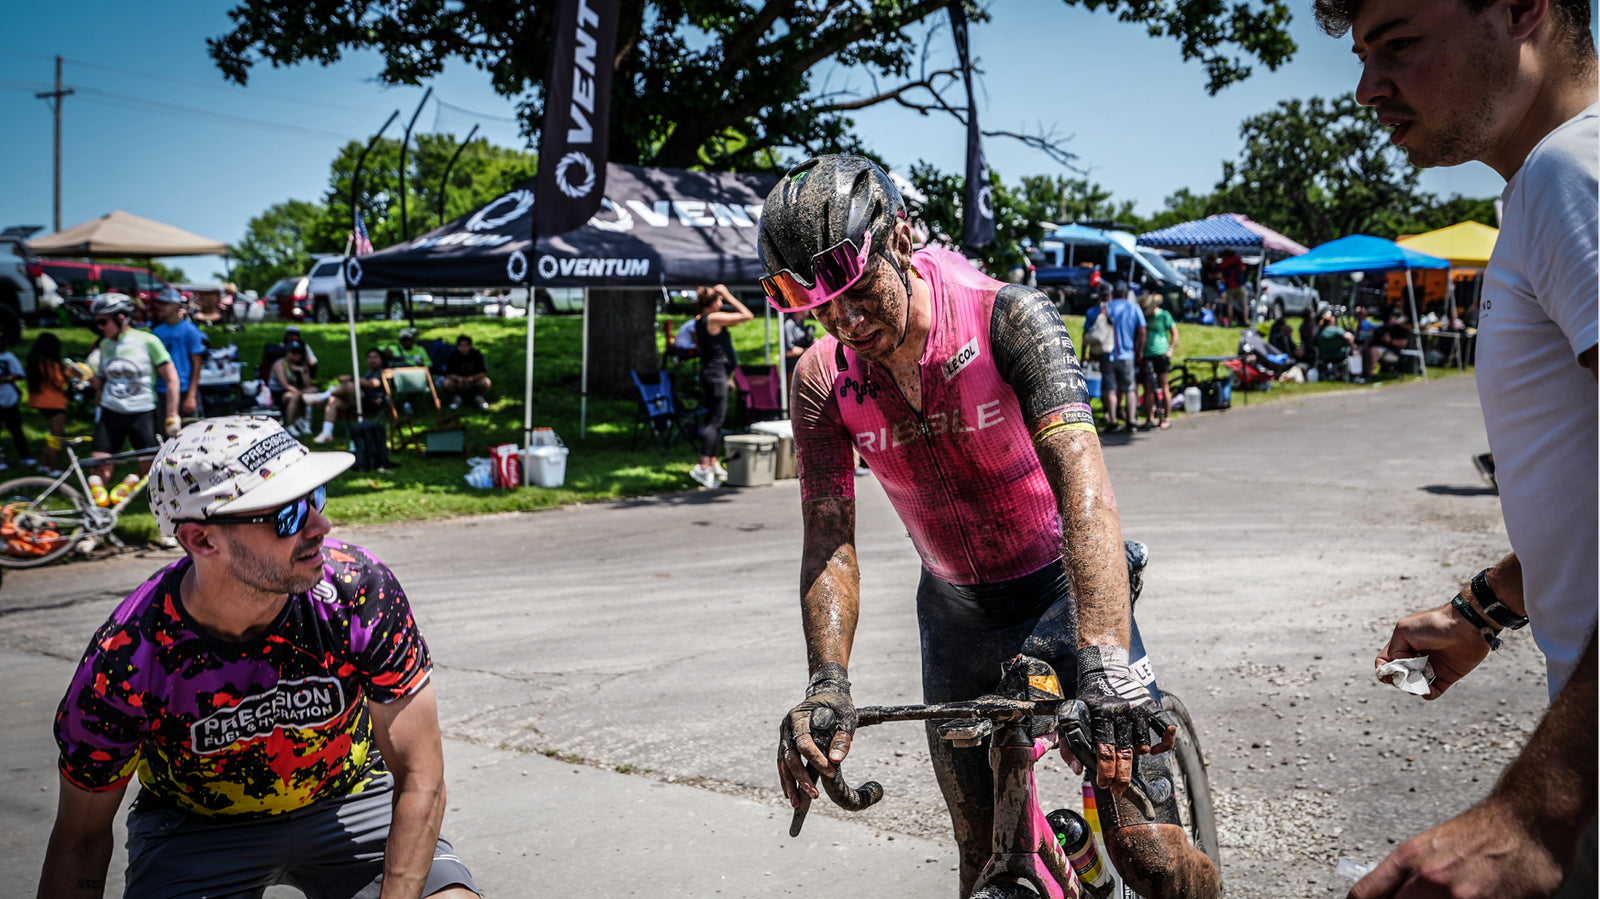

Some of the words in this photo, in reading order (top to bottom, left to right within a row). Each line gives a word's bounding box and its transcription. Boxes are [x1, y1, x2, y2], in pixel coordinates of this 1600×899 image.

[559, 258, 650, 277] VENTUM
[947, 359, 960, 375] LE
[957, 346, 976, 366] COL
[855, 399, 1006, 453] RIBBLE
